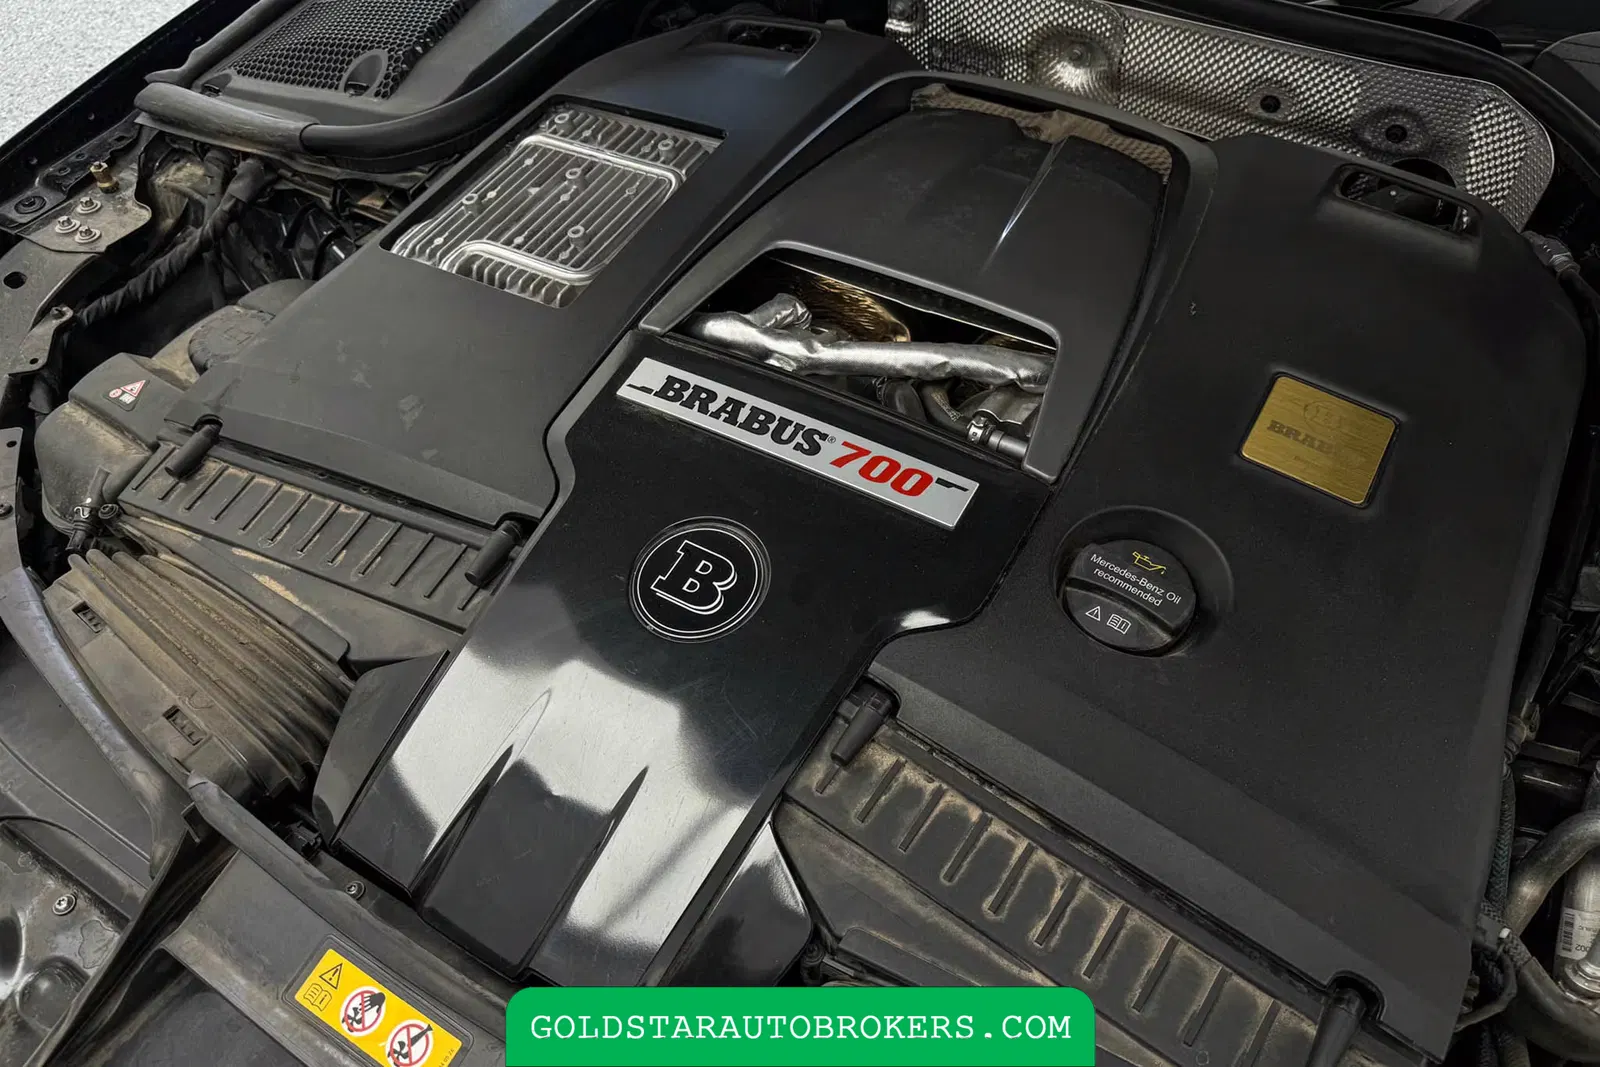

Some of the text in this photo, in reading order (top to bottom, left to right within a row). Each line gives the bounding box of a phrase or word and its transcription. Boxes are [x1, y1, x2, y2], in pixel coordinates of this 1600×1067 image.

[829, 441, 934, 497] 700
[651, 540, 737, 615] B
[1090, 553, 1182, 605] Mercedes-Benz Oil
[1093, 568, 1163, 607] recommended
